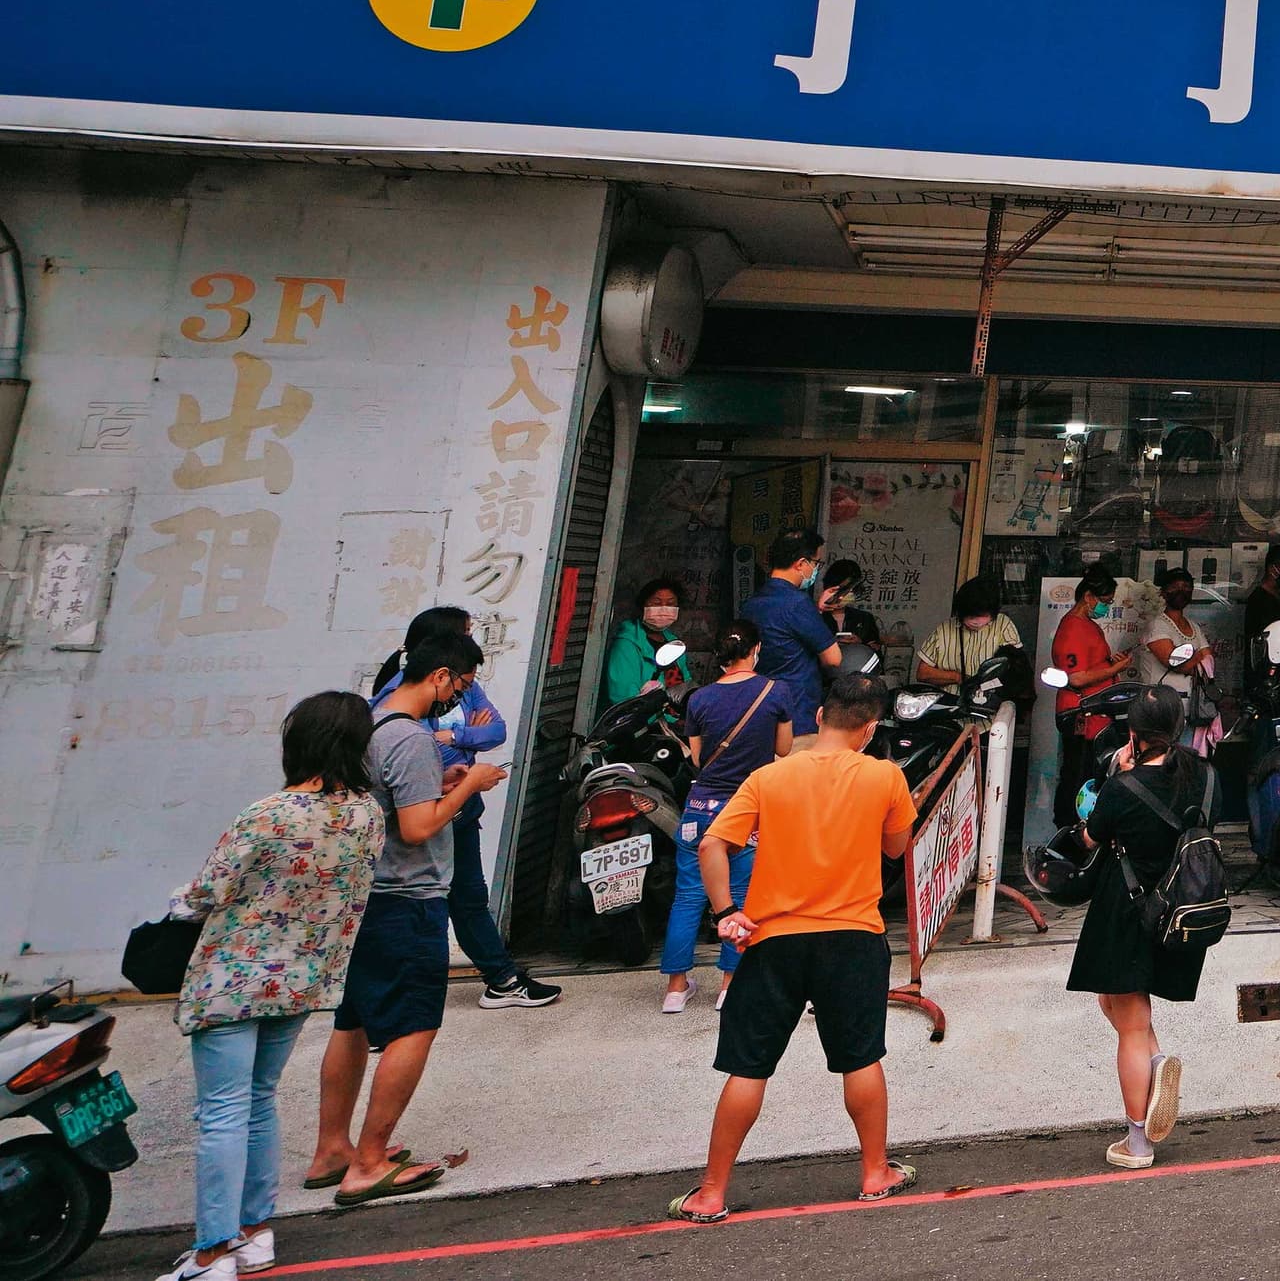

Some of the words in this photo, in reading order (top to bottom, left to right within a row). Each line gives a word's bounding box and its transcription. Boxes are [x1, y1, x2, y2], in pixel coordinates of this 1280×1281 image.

[180, 272, 346, 346] 3F
[130, 351, 315, 649] 出租
[838, 537, 923, 552] CRYSTAL
[1067, 654, 1077, 668] 3
